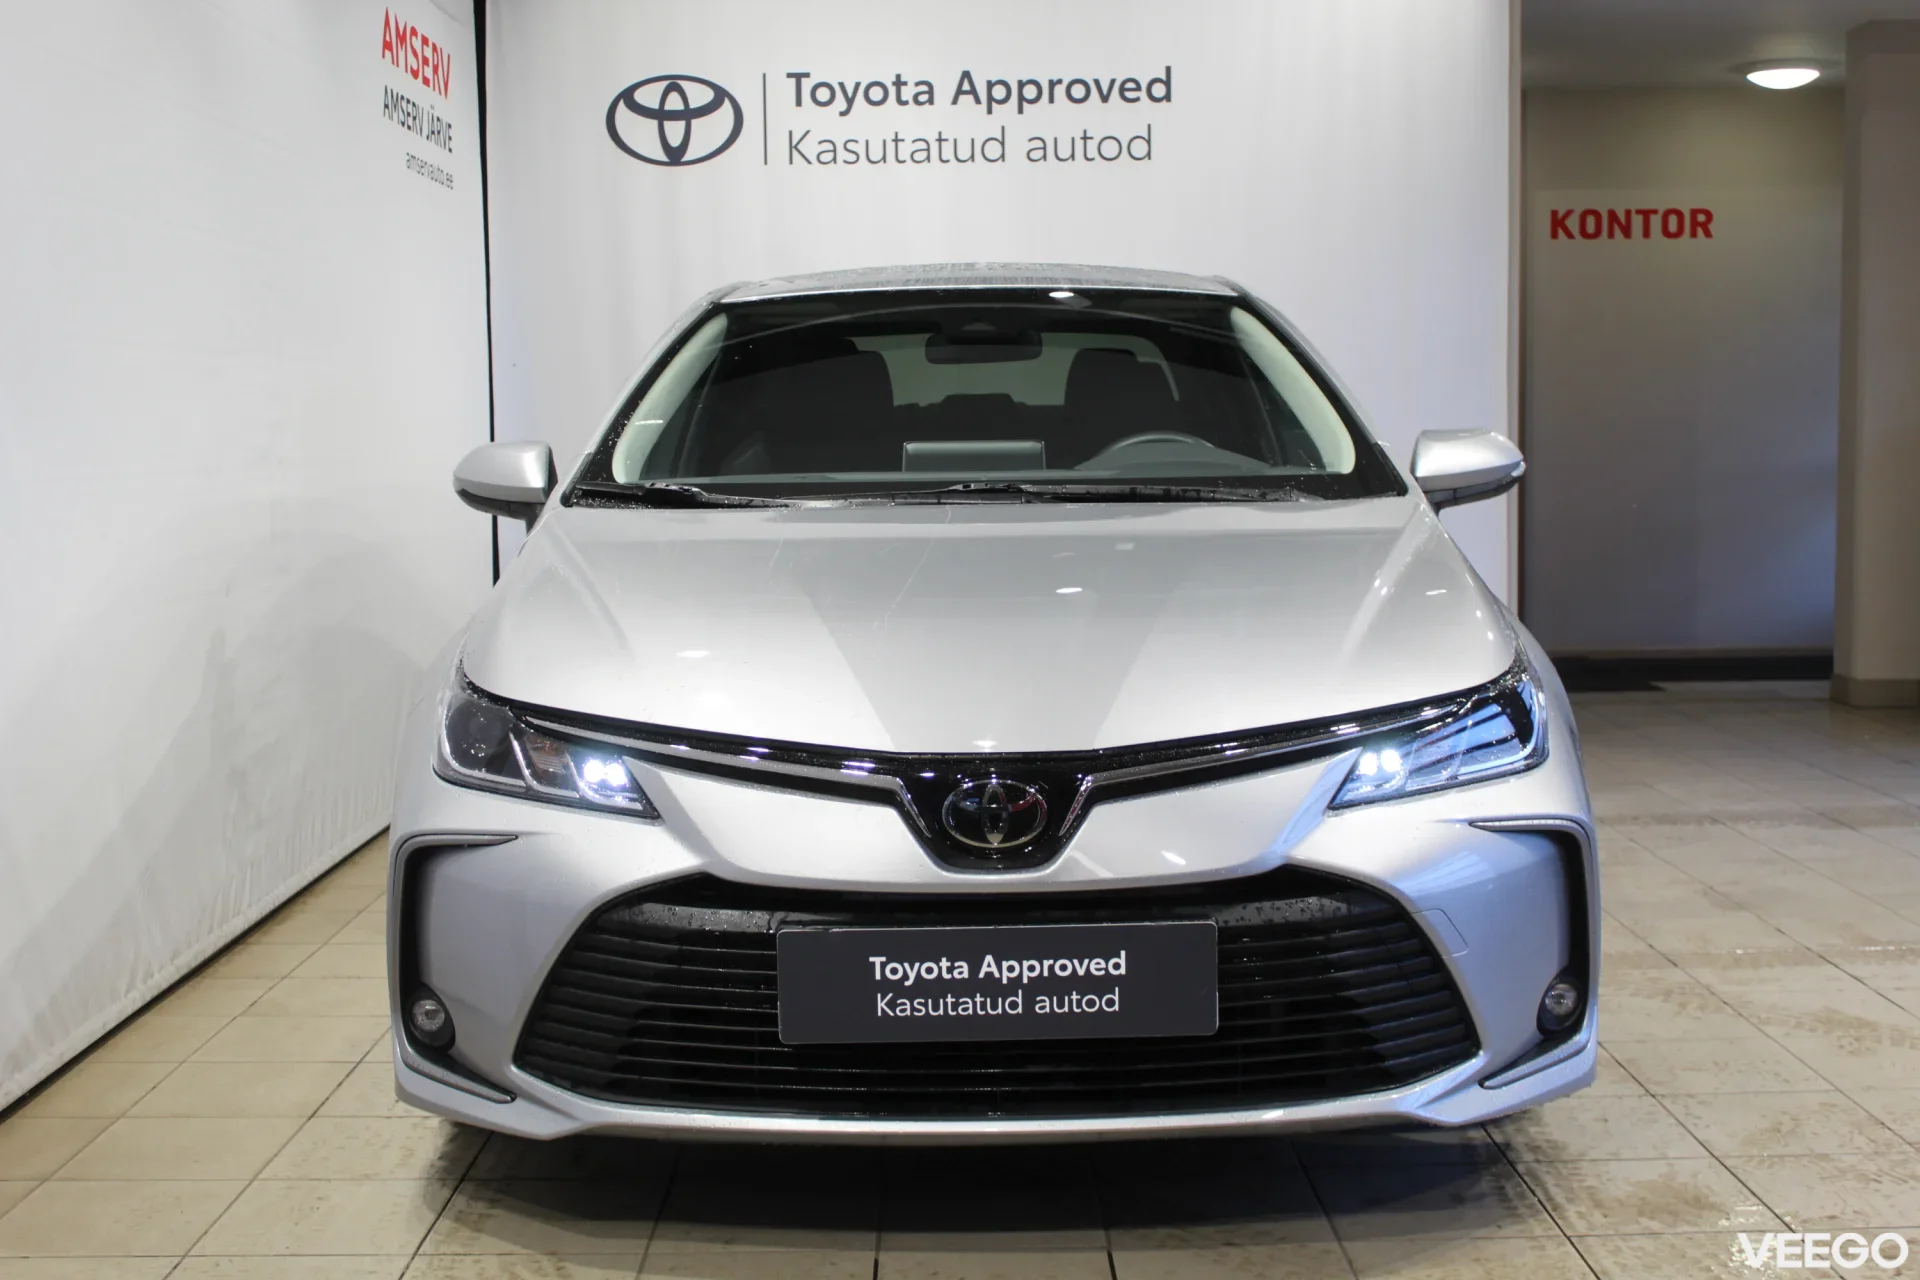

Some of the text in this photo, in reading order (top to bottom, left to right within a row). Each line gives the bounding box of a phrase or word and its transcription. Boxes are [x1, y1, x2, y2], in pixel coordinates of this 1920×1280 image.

[382, 6, 451, 100] AMSERV
[786, 66, 1173, 117] Toyota Approved
[383, 85, 453, 154] AMSERV JÄRVE
[787, 123, 1153, 165] Kasutatud autod
[406, 152, 454, 190] amservauto.ee
[1550, 208, 1714, 240] KONTOR
[869, 950, 1127, 986] Toyota Approved
[877, 987, 1120, 1017] Kasutatud autod
